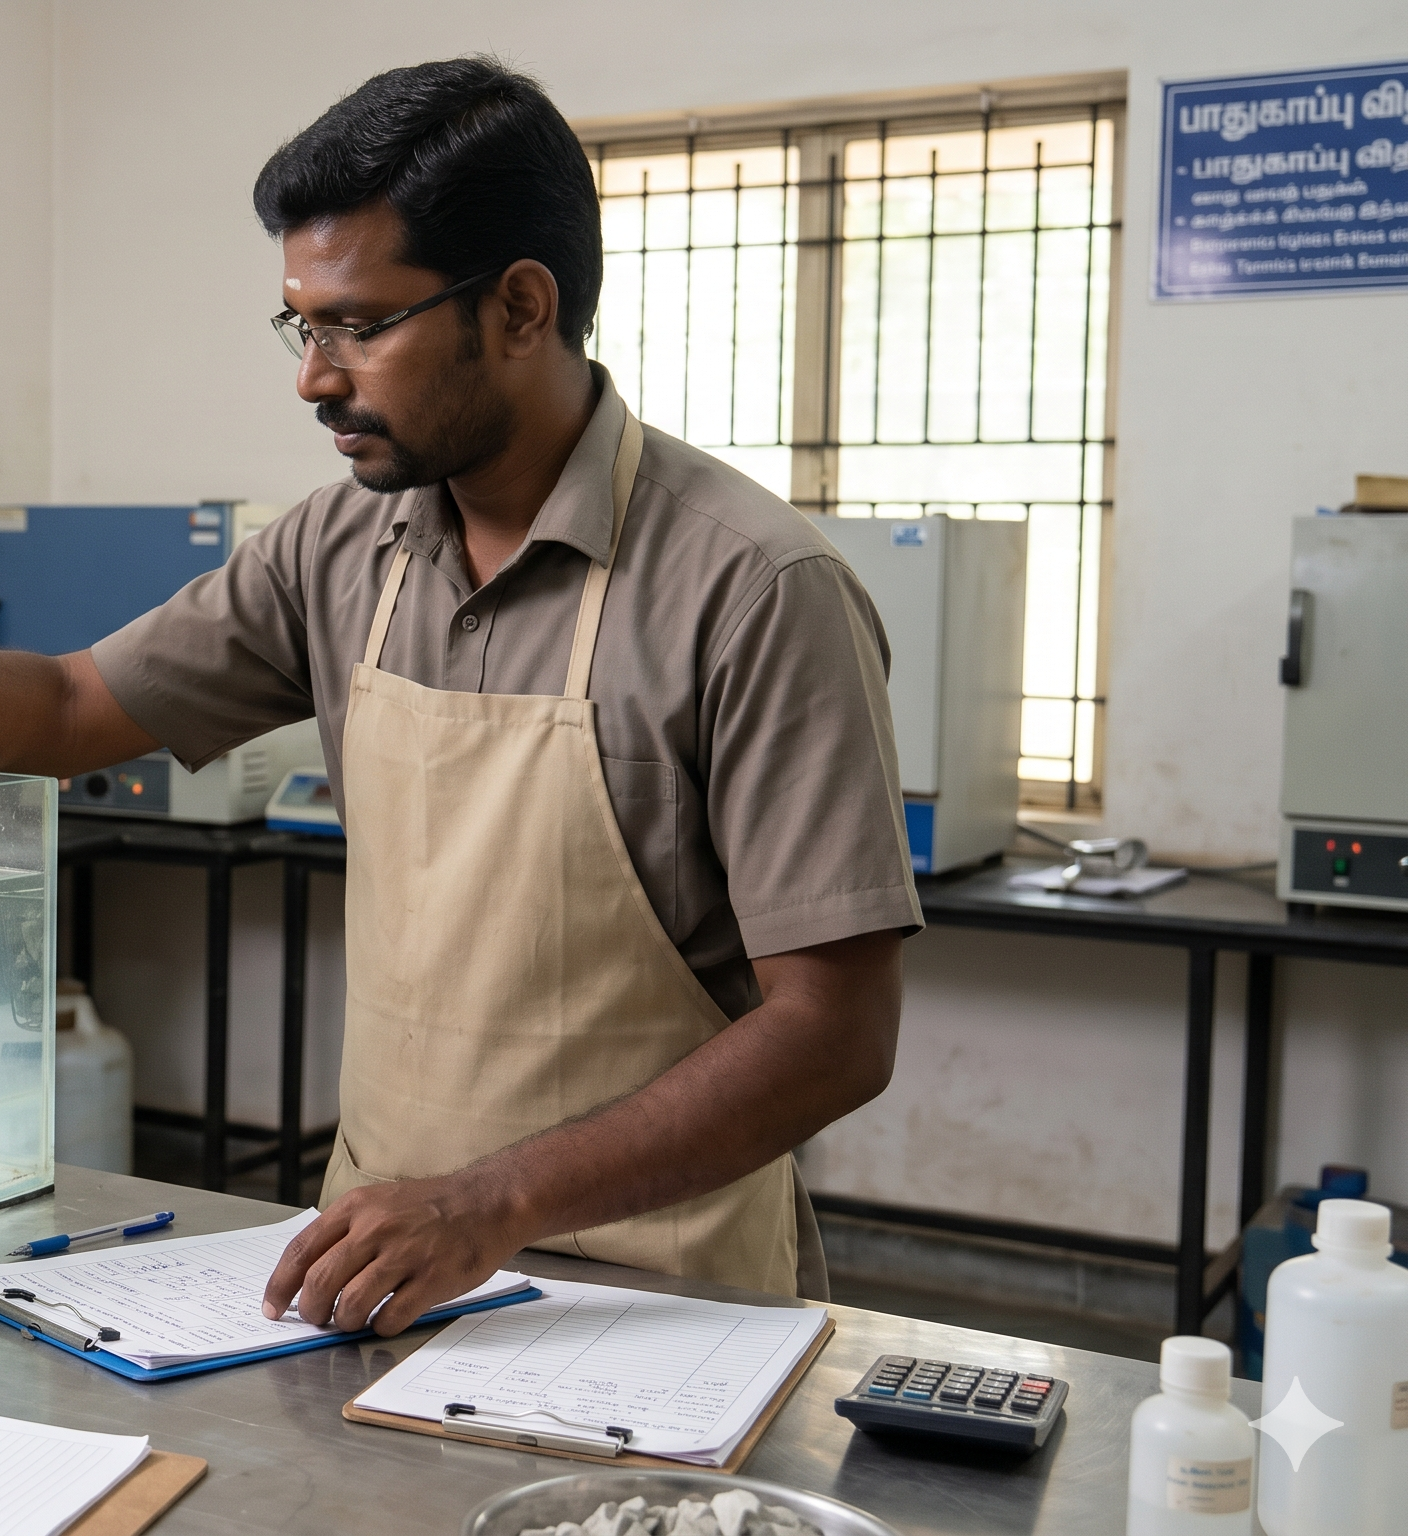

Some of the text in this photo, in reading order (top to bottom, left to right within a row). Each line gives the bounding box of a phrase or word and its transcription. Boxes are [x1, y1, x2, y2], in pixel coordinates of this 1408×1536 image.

[1179, 79, 1408, 142] பாதுகாப்பு வி
[1192, 142, 1350, 186] பாதுகாப்பு
